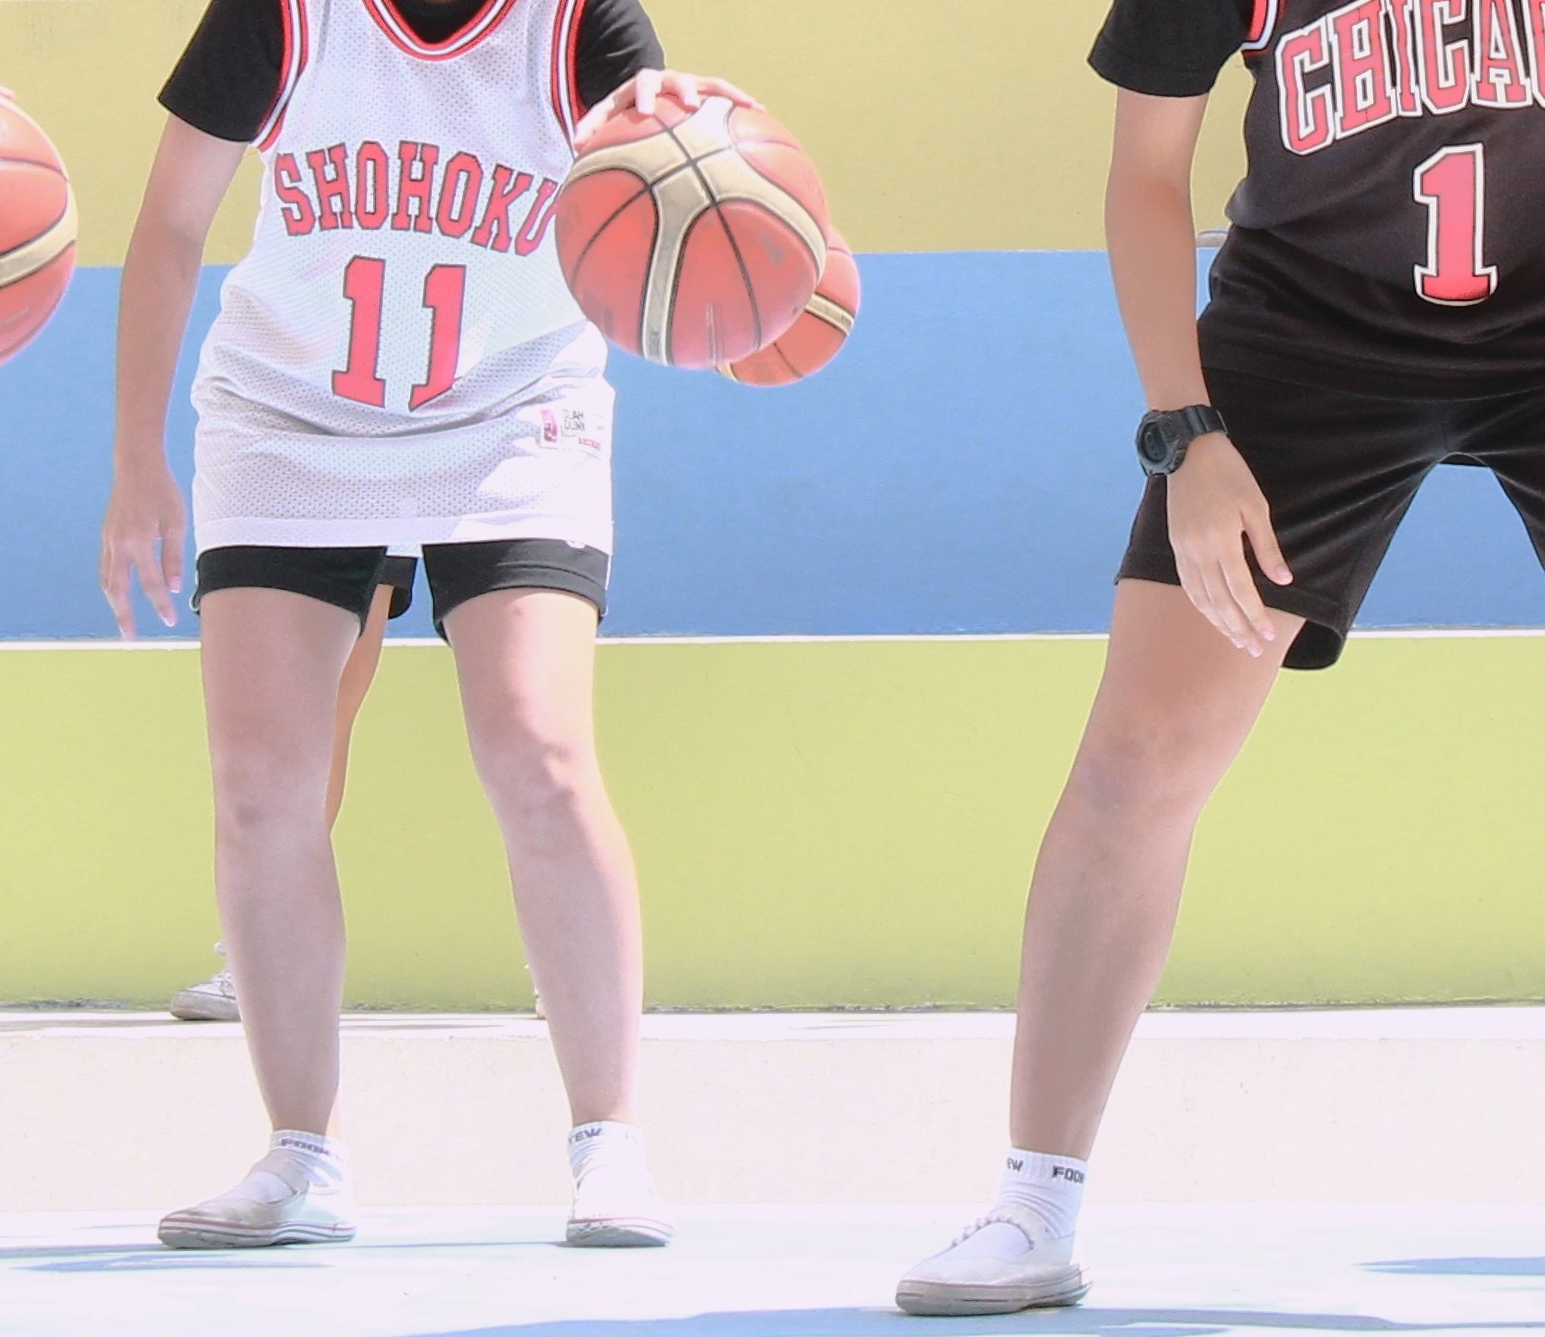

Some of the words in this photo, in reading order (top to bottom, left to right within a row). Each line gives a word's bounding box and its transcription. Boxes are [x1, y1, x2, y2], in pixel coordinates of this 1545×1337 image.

[274, 140, 558, 257] SHOHOKU
[1411, 142, 1498, 307] 1
[331, 254, 467, 413] 11
